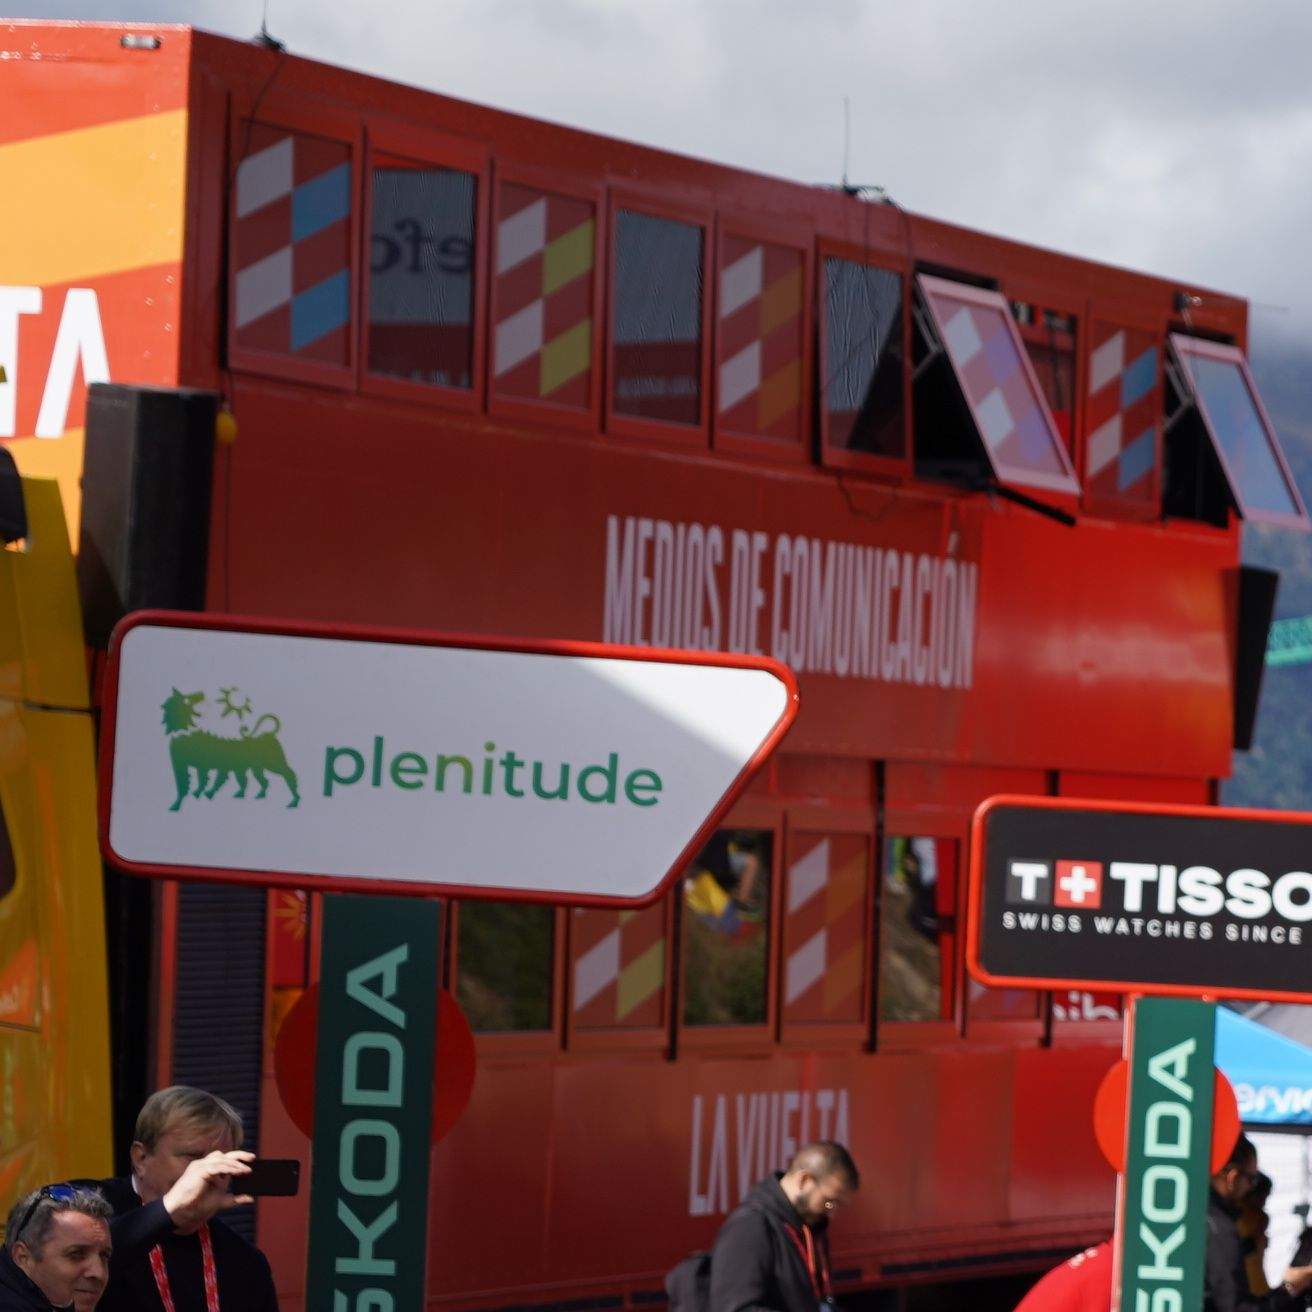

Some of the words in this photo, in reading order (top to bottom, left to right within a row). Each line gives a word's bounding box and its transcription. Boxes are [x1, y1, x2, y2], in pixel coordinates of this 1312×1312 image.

[603, 514, 724, 652] MEDIOS
[728, 528, 769, 656] DE
[771, 531, 978, 691] COMUNICACIÓN
[322, 736, 663, 806] plenitude
[1002, 911, 1082, 933] SWISS
[1094, 916, 1213, 940] WATCHES
[1225, 923, 1303, 945] SINCE
[689, 1094, 727, 1216] LA
